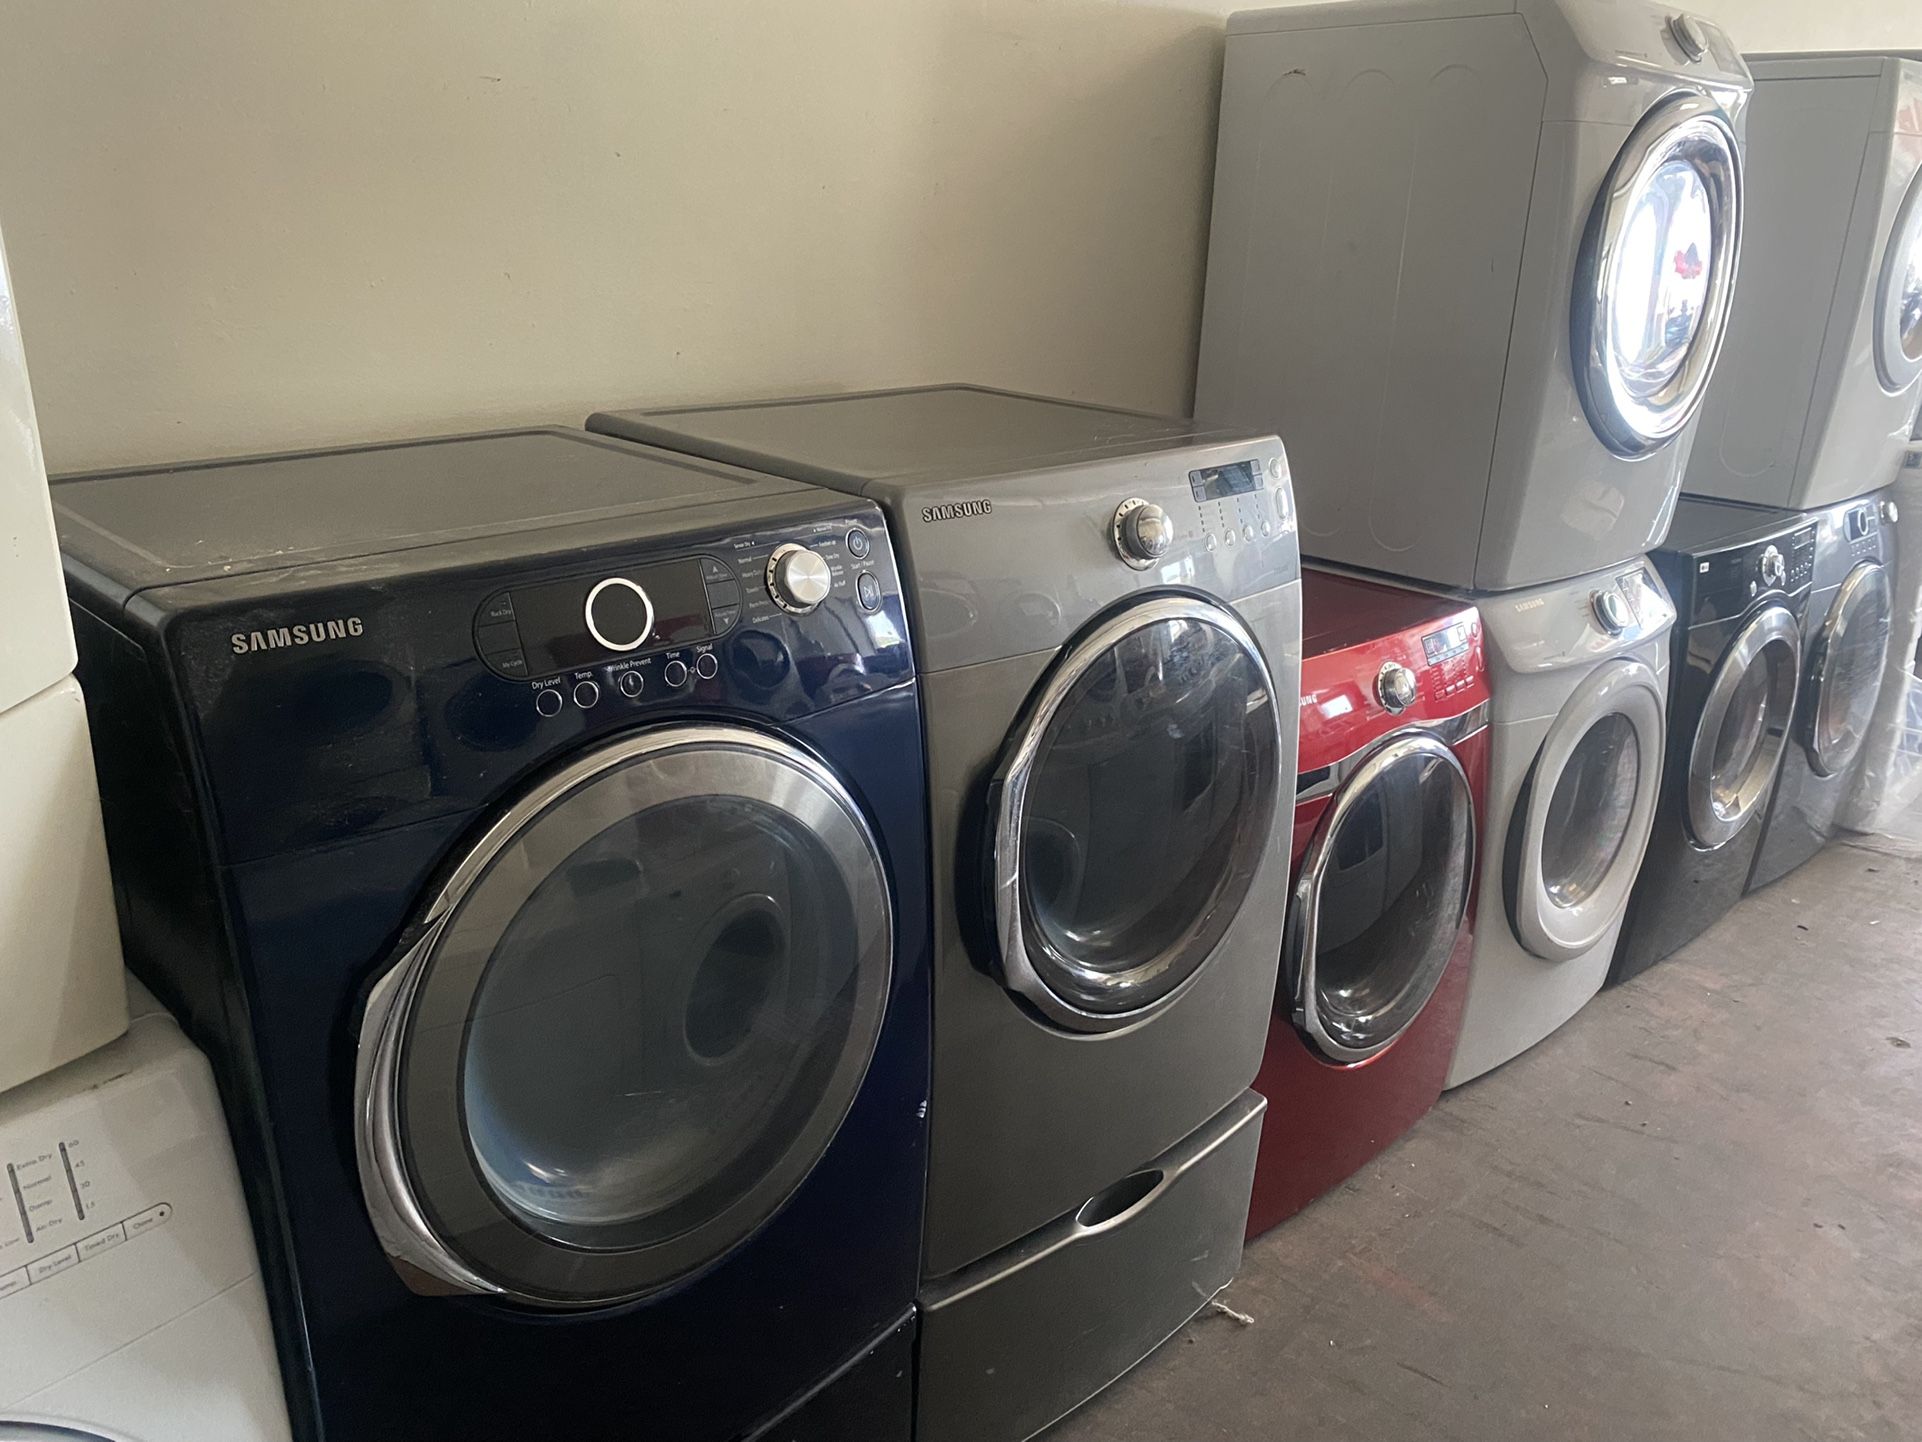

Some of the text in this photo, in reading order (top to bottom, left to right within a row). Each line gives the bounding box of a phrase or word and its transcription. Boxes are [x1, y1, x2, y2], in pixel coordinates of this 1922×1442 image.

[922, 498, 992, 523] SAMSUNG
[231, 617, 364, 654] SAMSUNG
[696, 643, 713, 654] Signal
[666, 651, 681, 660] Time
[629, 657, 652, 668] Prevent
[531, 676, 561, 691] Dry Level
